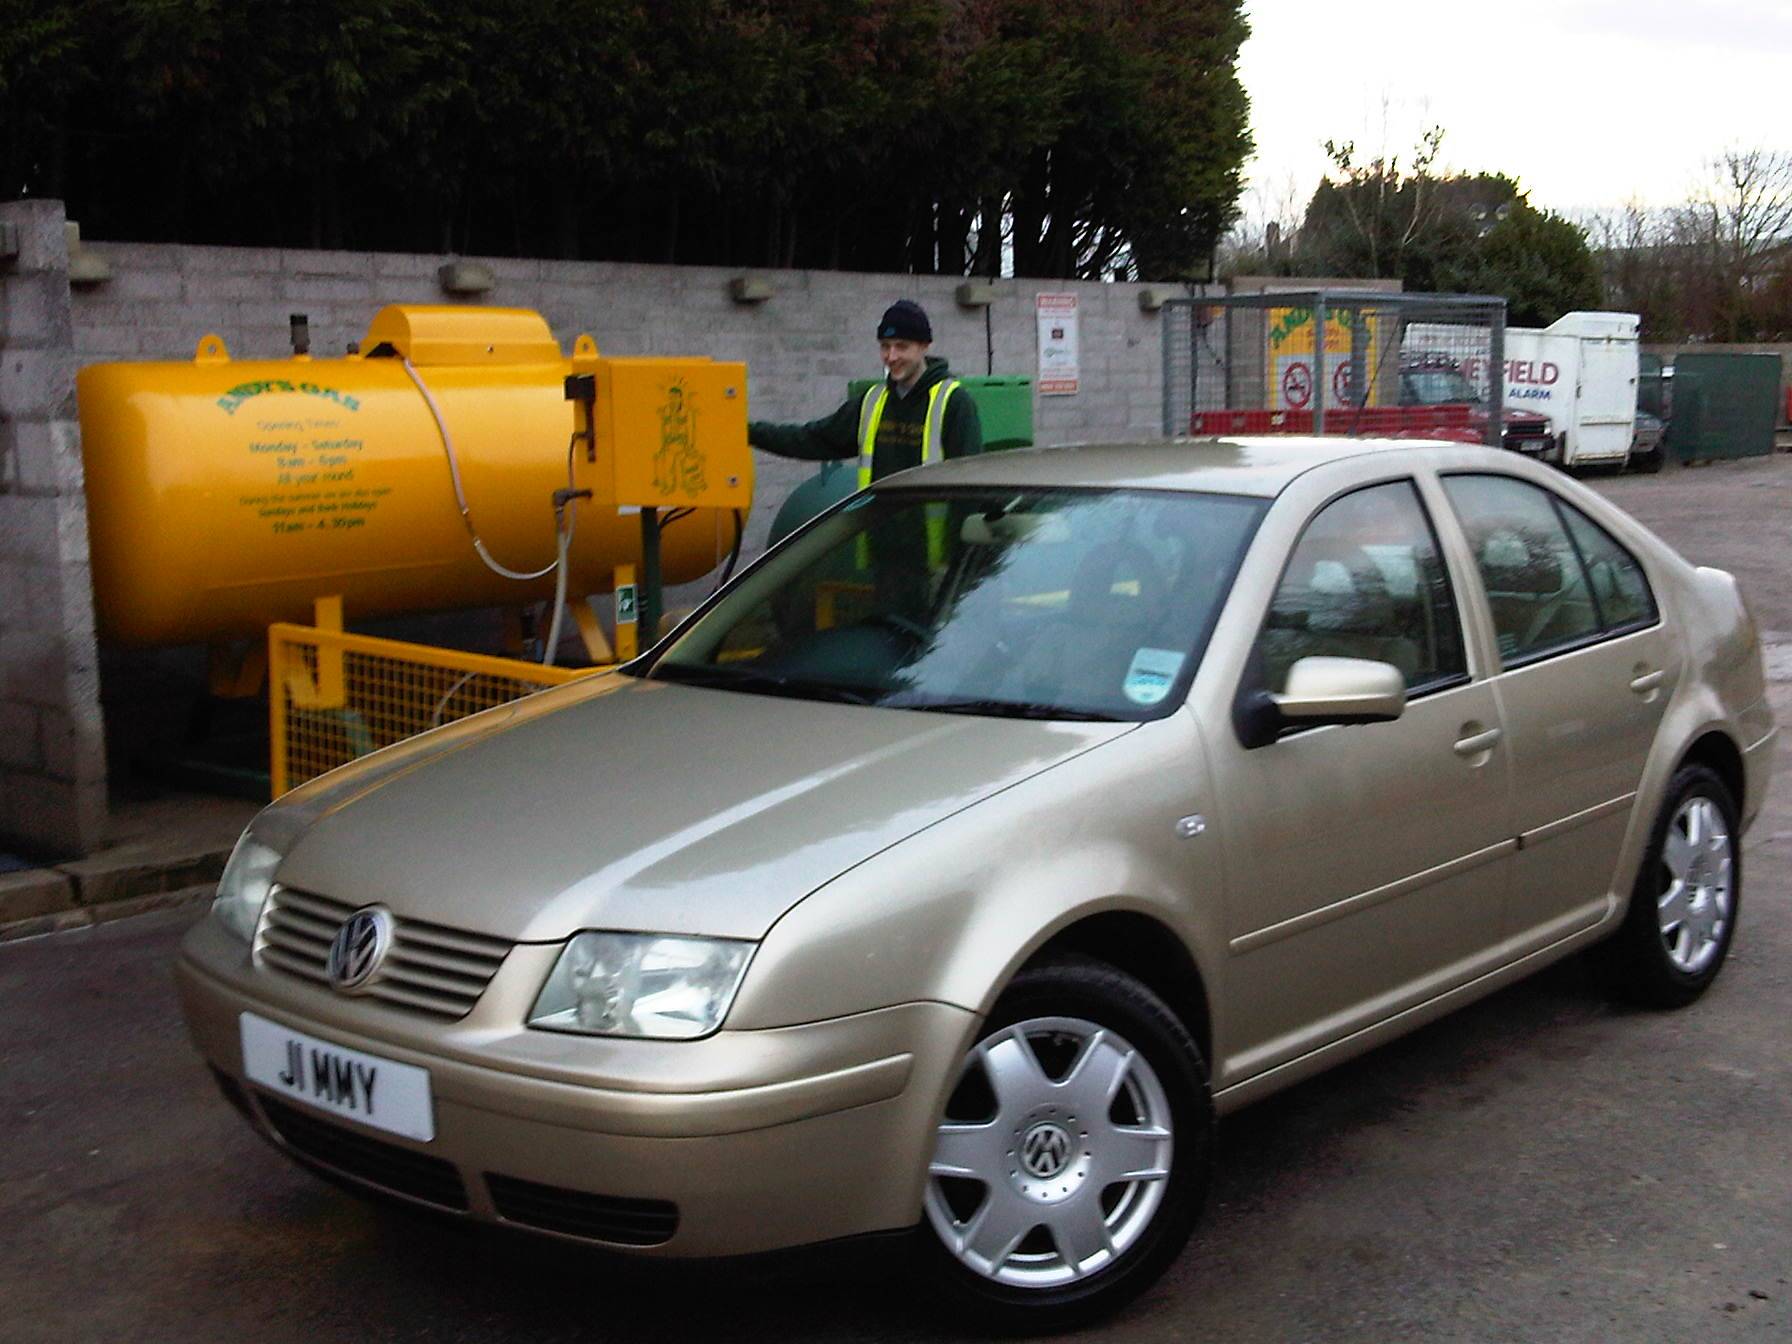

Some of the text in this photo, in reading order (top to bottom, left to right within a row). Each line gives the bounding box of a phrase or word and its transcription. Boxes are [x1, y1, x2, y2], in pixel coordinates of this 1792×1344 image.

[1508, 388, 1551, 400] ALARM
[249, 440, 297, 454] Monday
[311, 438, 363, 450] Saturday
